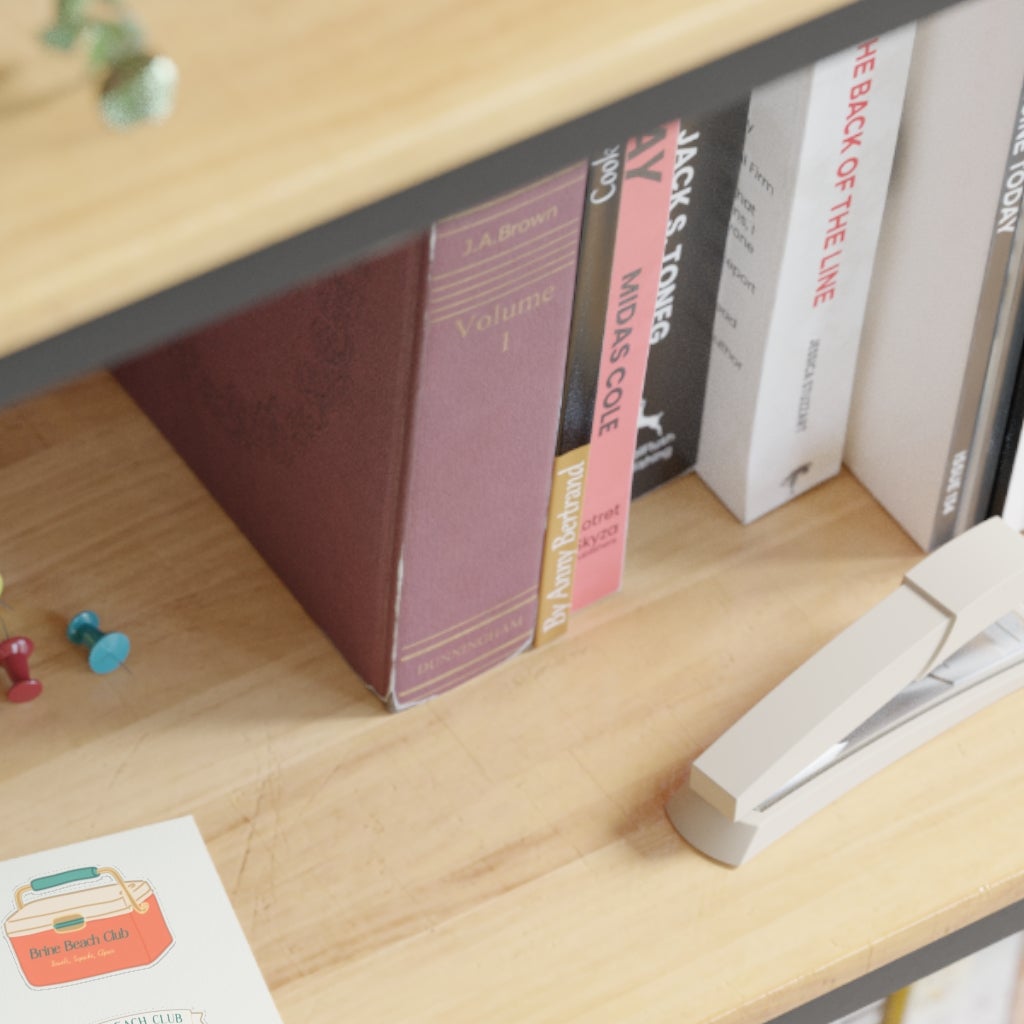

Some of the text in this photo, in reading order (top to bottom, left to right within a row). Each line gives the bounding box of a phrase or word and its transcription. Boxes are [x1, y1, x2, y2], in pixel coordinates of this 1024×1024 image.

[668, 129, 701, 212] JACK
[812, 36, 879, 309] HE BACK OF THE LINE
[996, 158, 1024, 234] TODAY
[454, 284, 556, 338] Volume
[598, 267, 643, 437] MIDAS COLE
[551, 460, 585, 551] Bertrand
[542, 603, 572, 634] By
[29, 945, 60, 960] Brine
[64, 933, 100, 952] Beach
[103, 927, 129, 942] Club
[152, 1012, 183, 1024] CLUB
